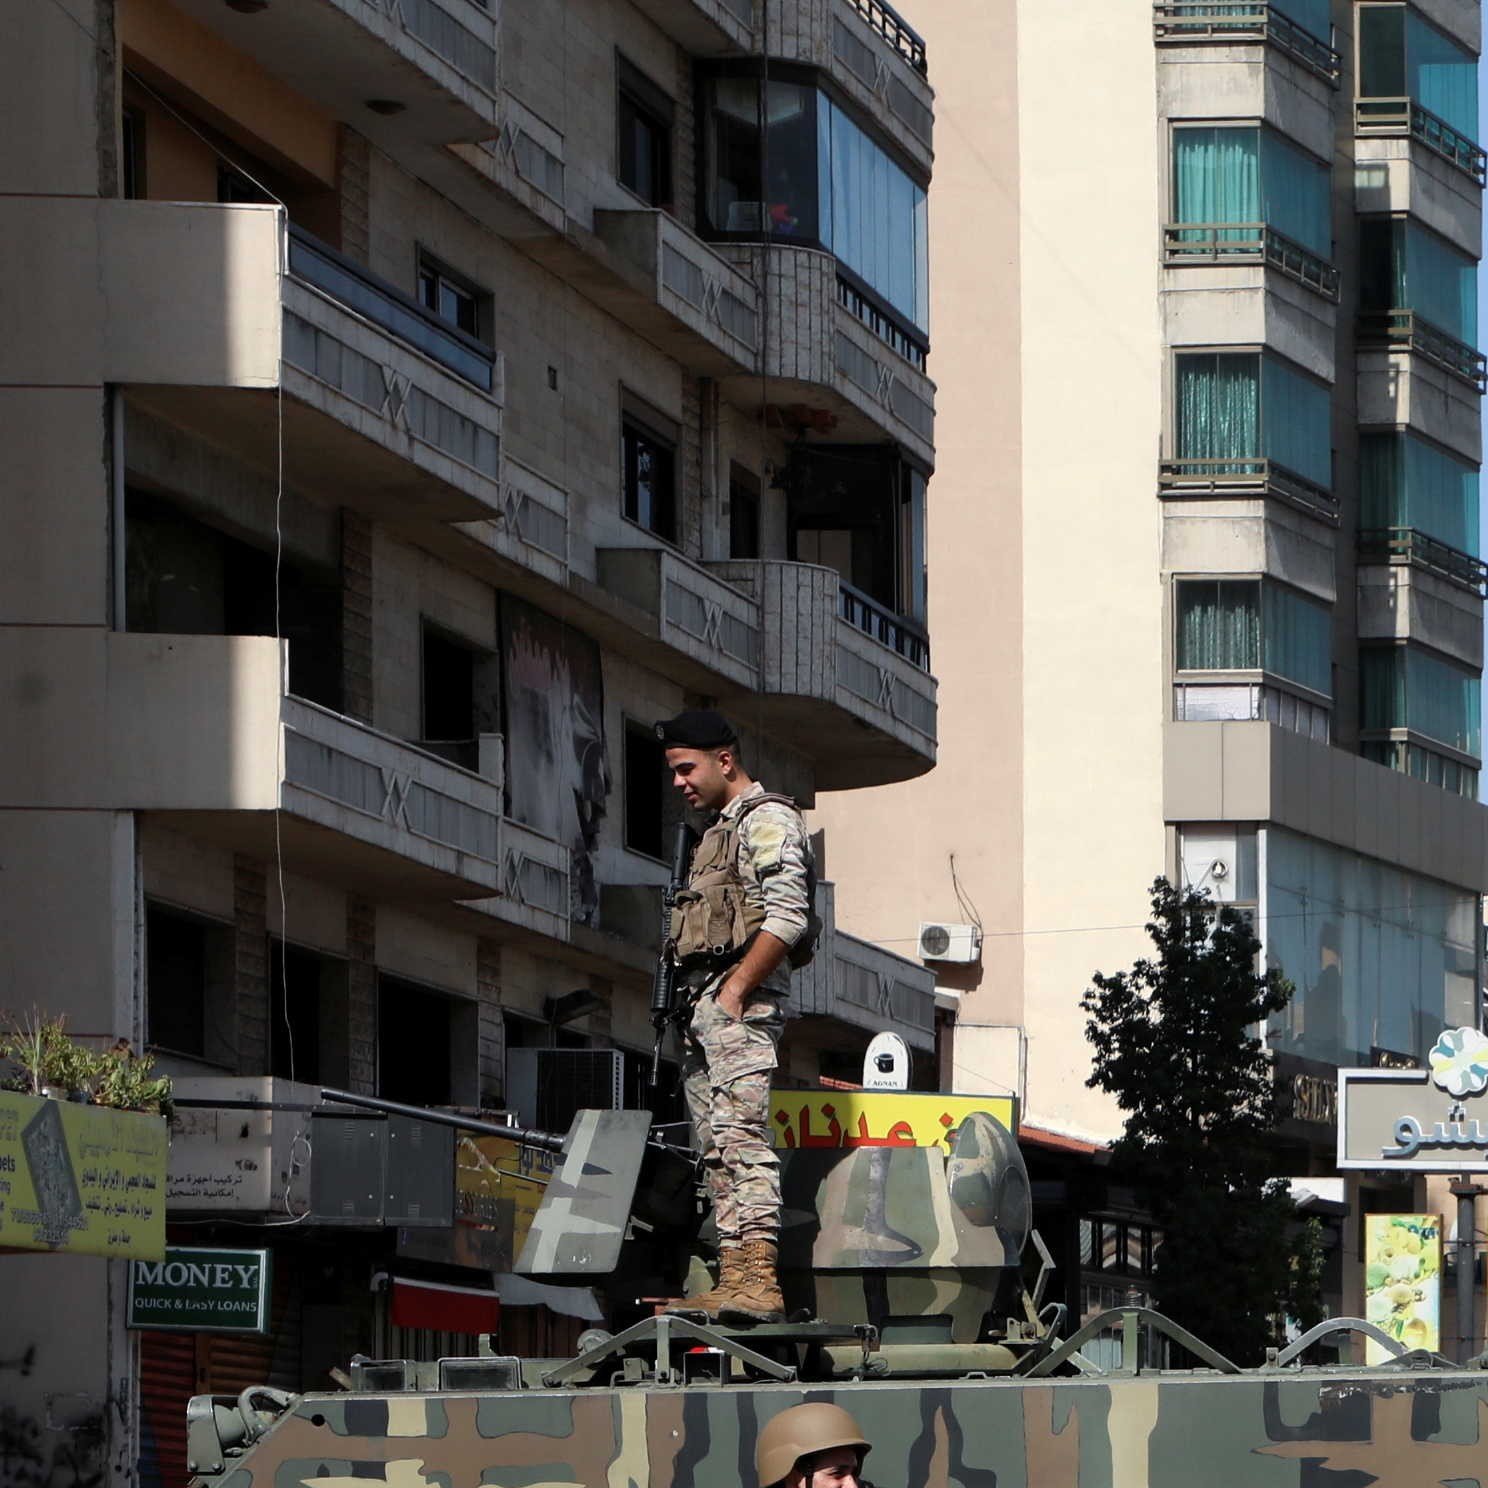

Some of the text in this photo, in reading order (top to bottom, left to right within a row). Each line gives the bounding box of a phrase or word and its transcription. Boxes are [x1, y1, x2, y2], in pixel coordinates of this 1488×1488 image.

[136, 1261, 258, 1288] MONEY
[134, 1297, 171, 1310] QUICK
[174, 1299, 183, 1310] &
[217, 1301, 257, 1313] LOANS
